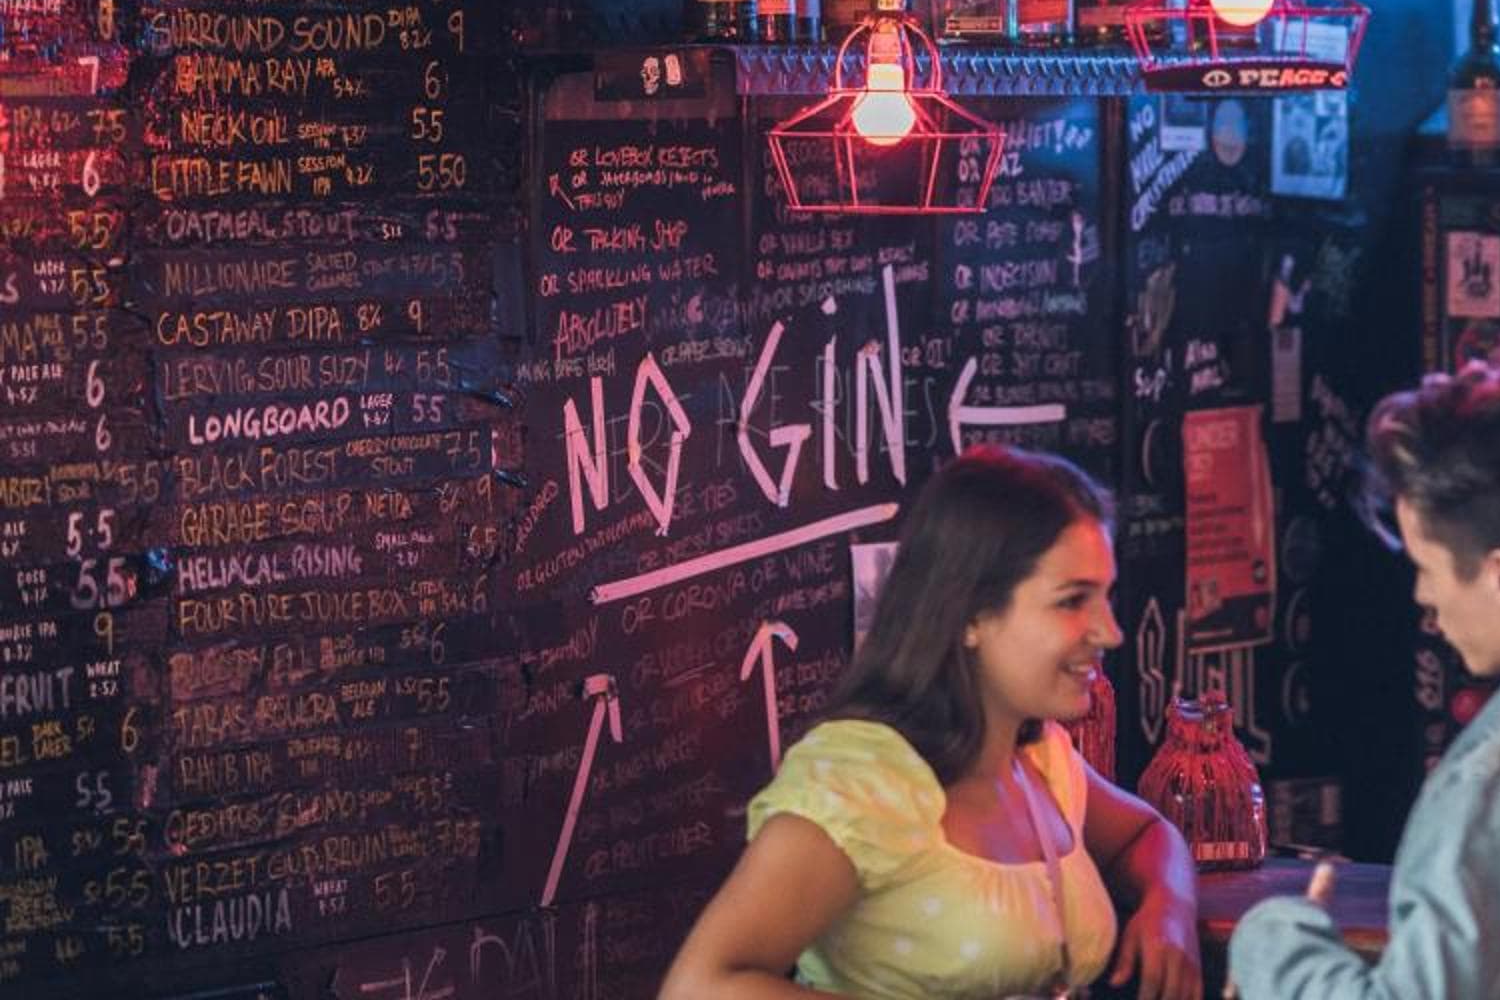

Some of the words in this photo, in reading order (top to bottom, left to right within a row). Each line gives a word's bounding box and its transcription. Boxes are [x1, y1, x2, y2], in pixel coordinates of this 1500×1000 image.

[150, 10, 285, 52] SURROUND
[292, 10, 387, 52] SOUND
[446, 9, 465, 52] 9
[266, 56, 312, 99] RAY
[424, 59, 442, 101] 6
[180, 108, 249, 148] NECK
[252, 112, 290, 146] OIL
[82, 150, 101, 198] 6
[150, 154, 231, 200] LITTLE
[235, 157, 293, 196] FAWN
[164, 208, 276, 242] OATMEAL
[164, 258, 298, 297] MILLIONAIRE
[658, 252, 719, 281] WATER
[156, 305, 279, 347] CASTAWAY
[286, 305, 343, 343] DIPA
[407, 300, 423, 332] 9
[554, 295, 649, 362] ABSOLUTELY
[85, 359, 106, 408] 6
[257, 354, 313, 394] SOUR
[95, 413, 112, 452] 6
[188, 395, 350, 446] LONGBOARD
[564, 350, 692, 537] NO
[259, 446, 338, 490] FOREST
[176, 552, 287, 594] HELIACAL
[289, 544, 364, 580] RISING
[661, 571, 748, 622] CORONA
[784, 540, 836, 579] WINE
[366, 587, 411, 619] BOX
[93, 611, 114, 655] 9
[120, 705, 141, 753] 6
[176, 887, 293, 950] CLAUDIA
